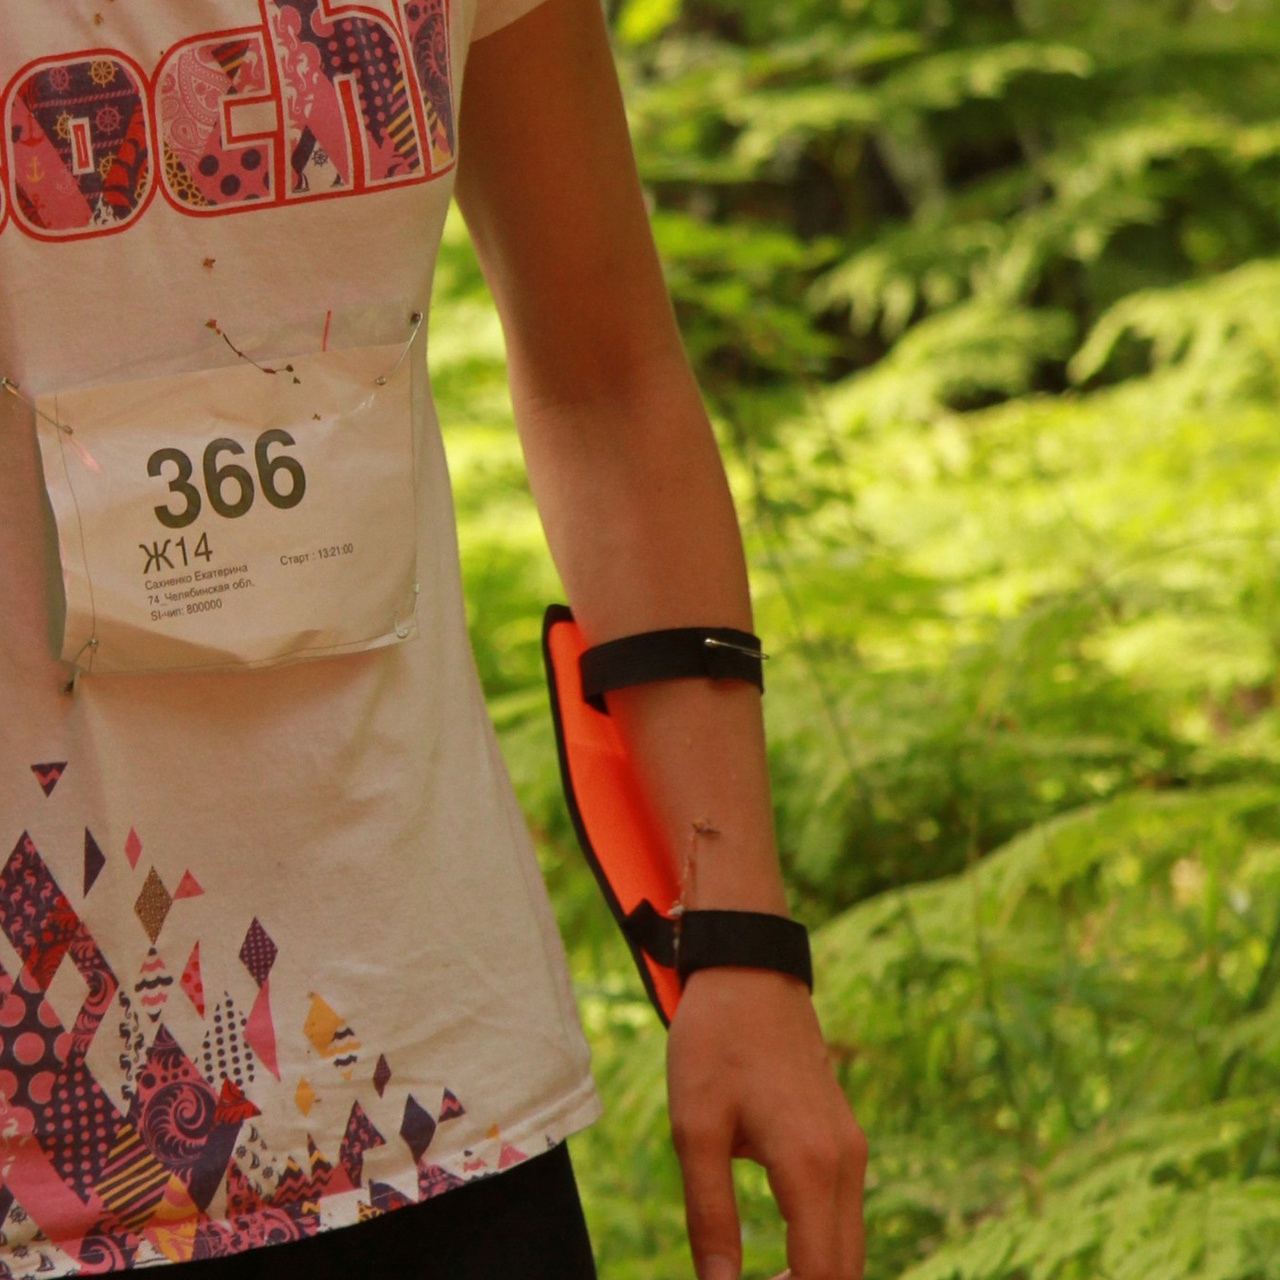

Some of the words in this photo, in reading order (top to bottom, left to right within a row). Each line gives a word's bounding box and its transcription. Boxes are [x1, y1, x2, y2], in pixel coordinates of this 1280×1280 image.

[147, 429, 306, 529] 366
[139, 532, 213, 574] Ж14
[280, 554, 309, 565] Старт
[194, 565, 248, 581] Екатерина
[232, 579, 256, 590] обл.
[186, 598, 222, 614] 800000
